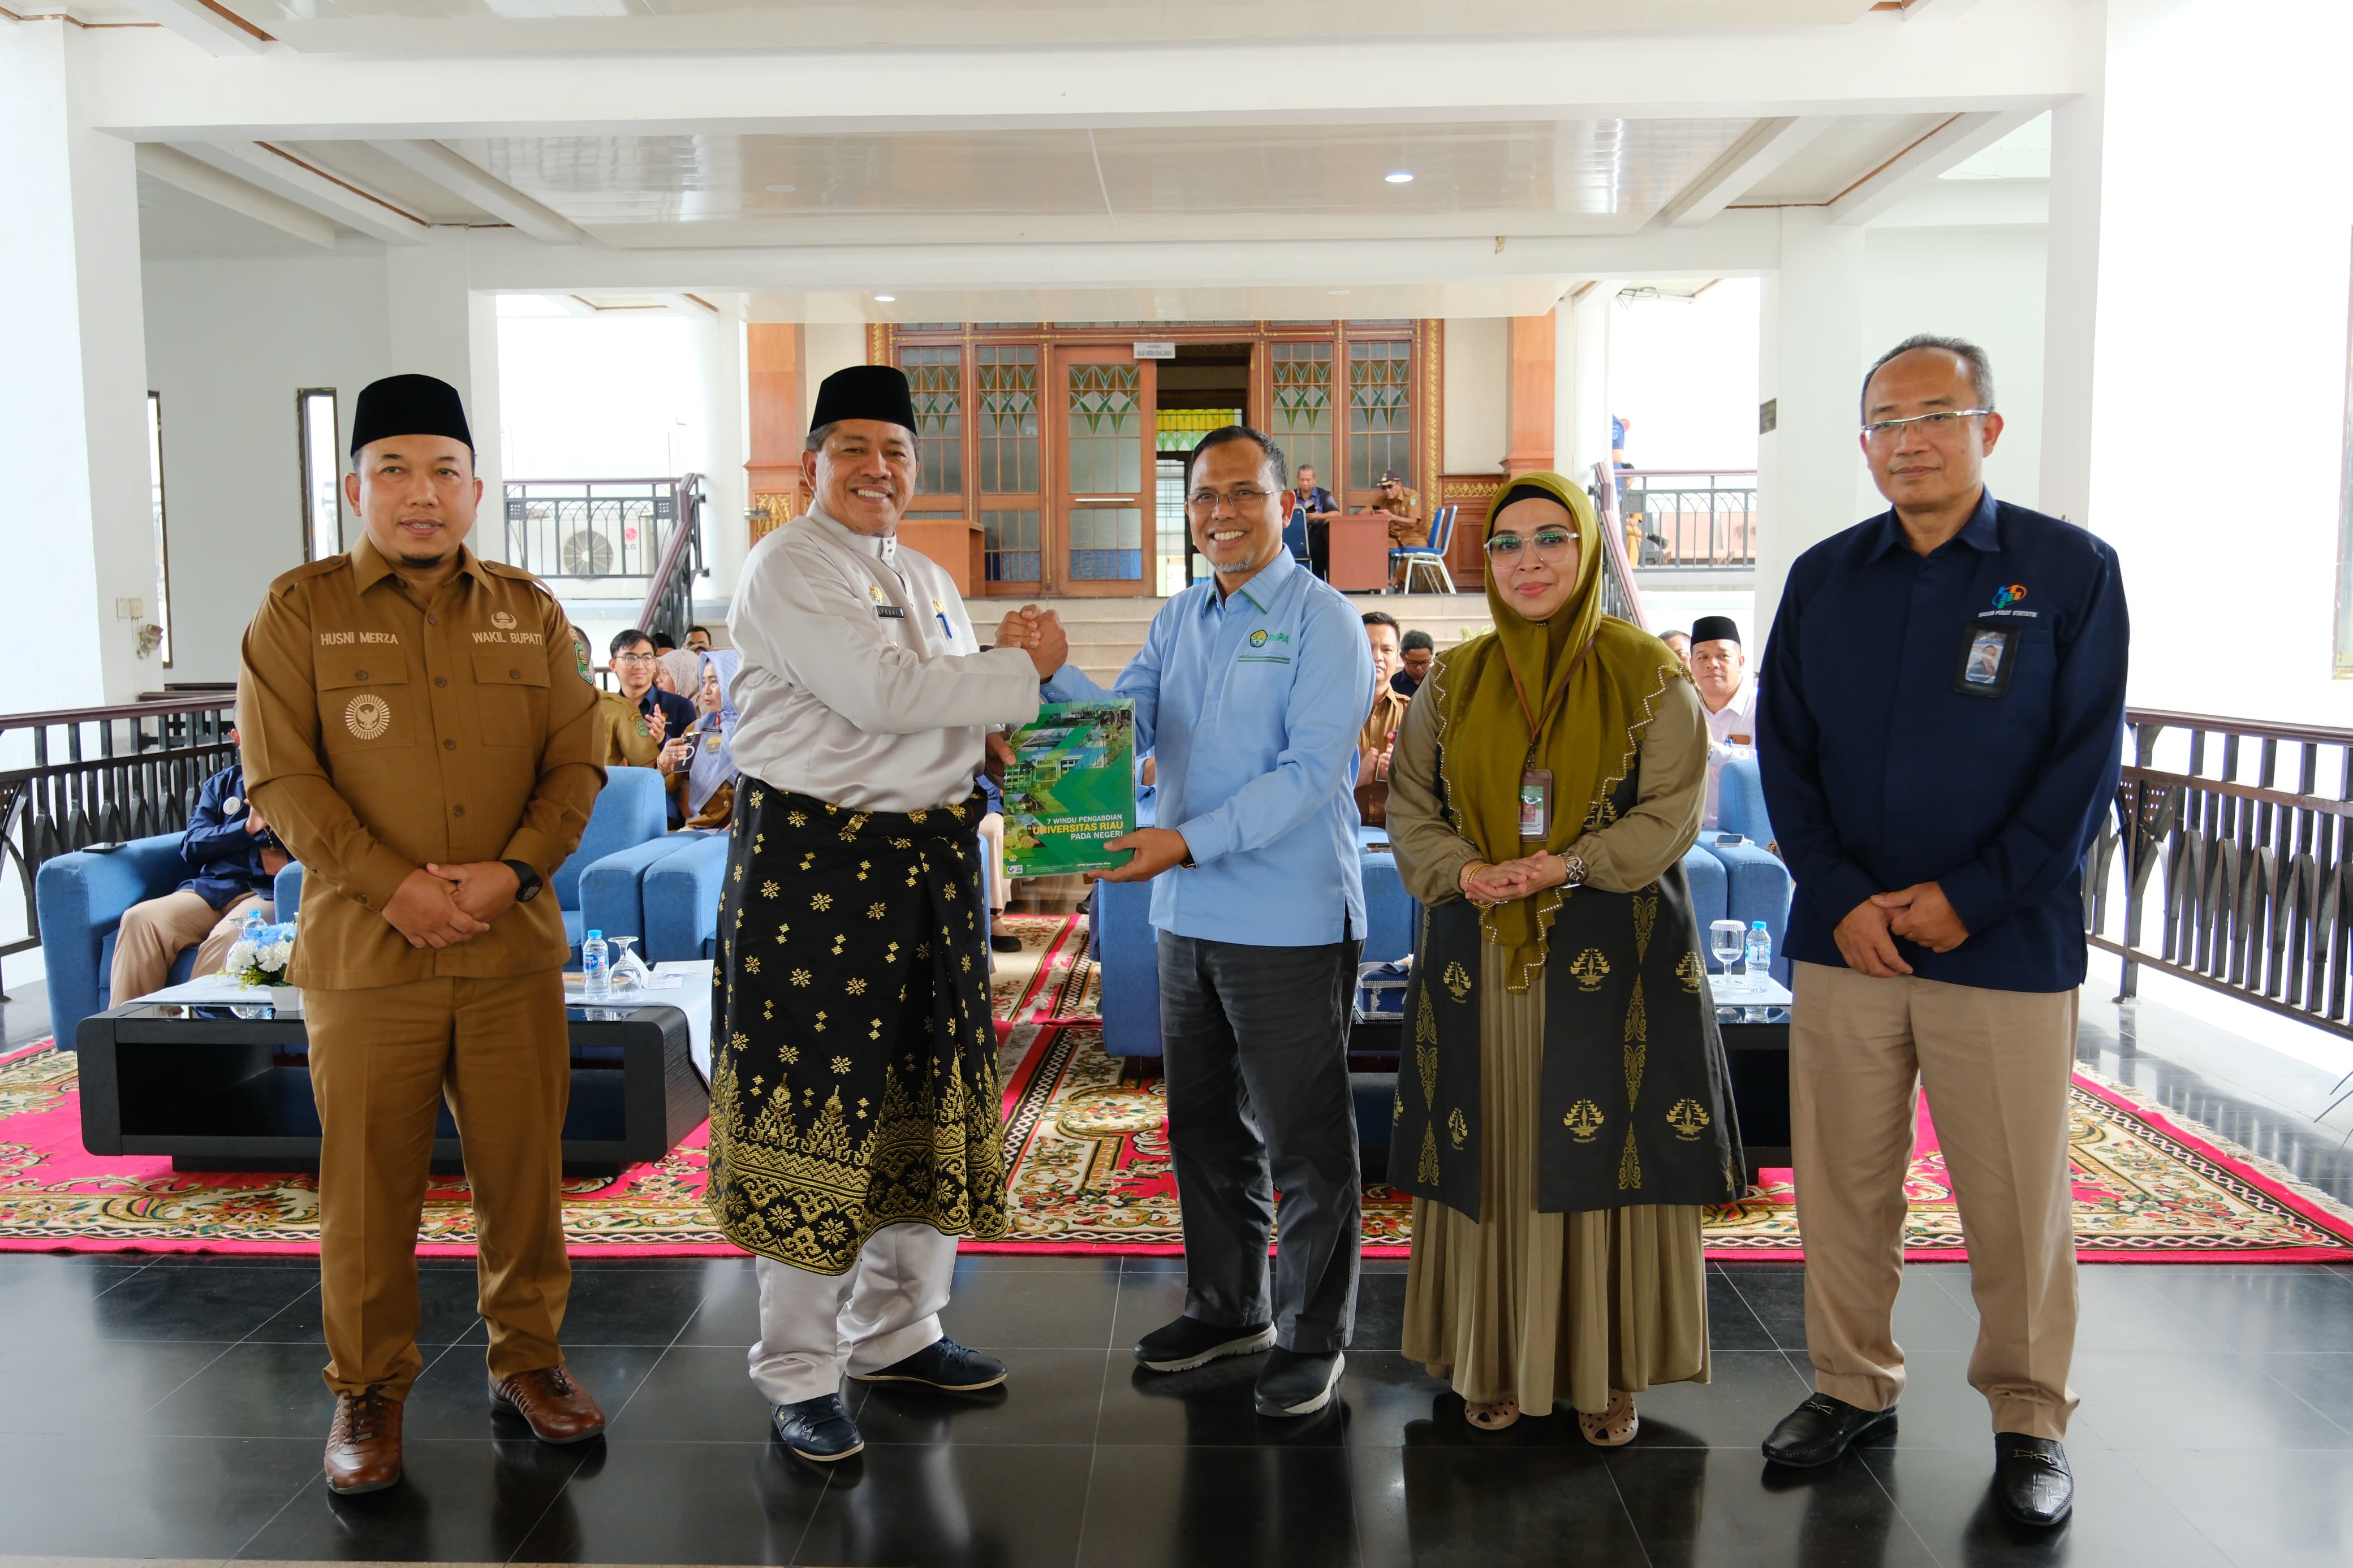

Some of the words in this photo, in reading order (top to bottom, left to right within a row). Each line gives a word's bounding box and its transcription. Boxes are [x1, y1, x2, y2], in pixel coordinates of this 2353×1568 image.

[321, 632, 355, 645] HUSNI
[359, 632, 398, 645] MERZA
[472, 632, 507, 643] WAKIL
[510, 632, 542, 646] BUPATI
[1033, 823, 1097, 834] UNIVERSITAS
[1100, 821, 1123, 830] RIAU
[1094, 830, 1123, 839] NEGERI
